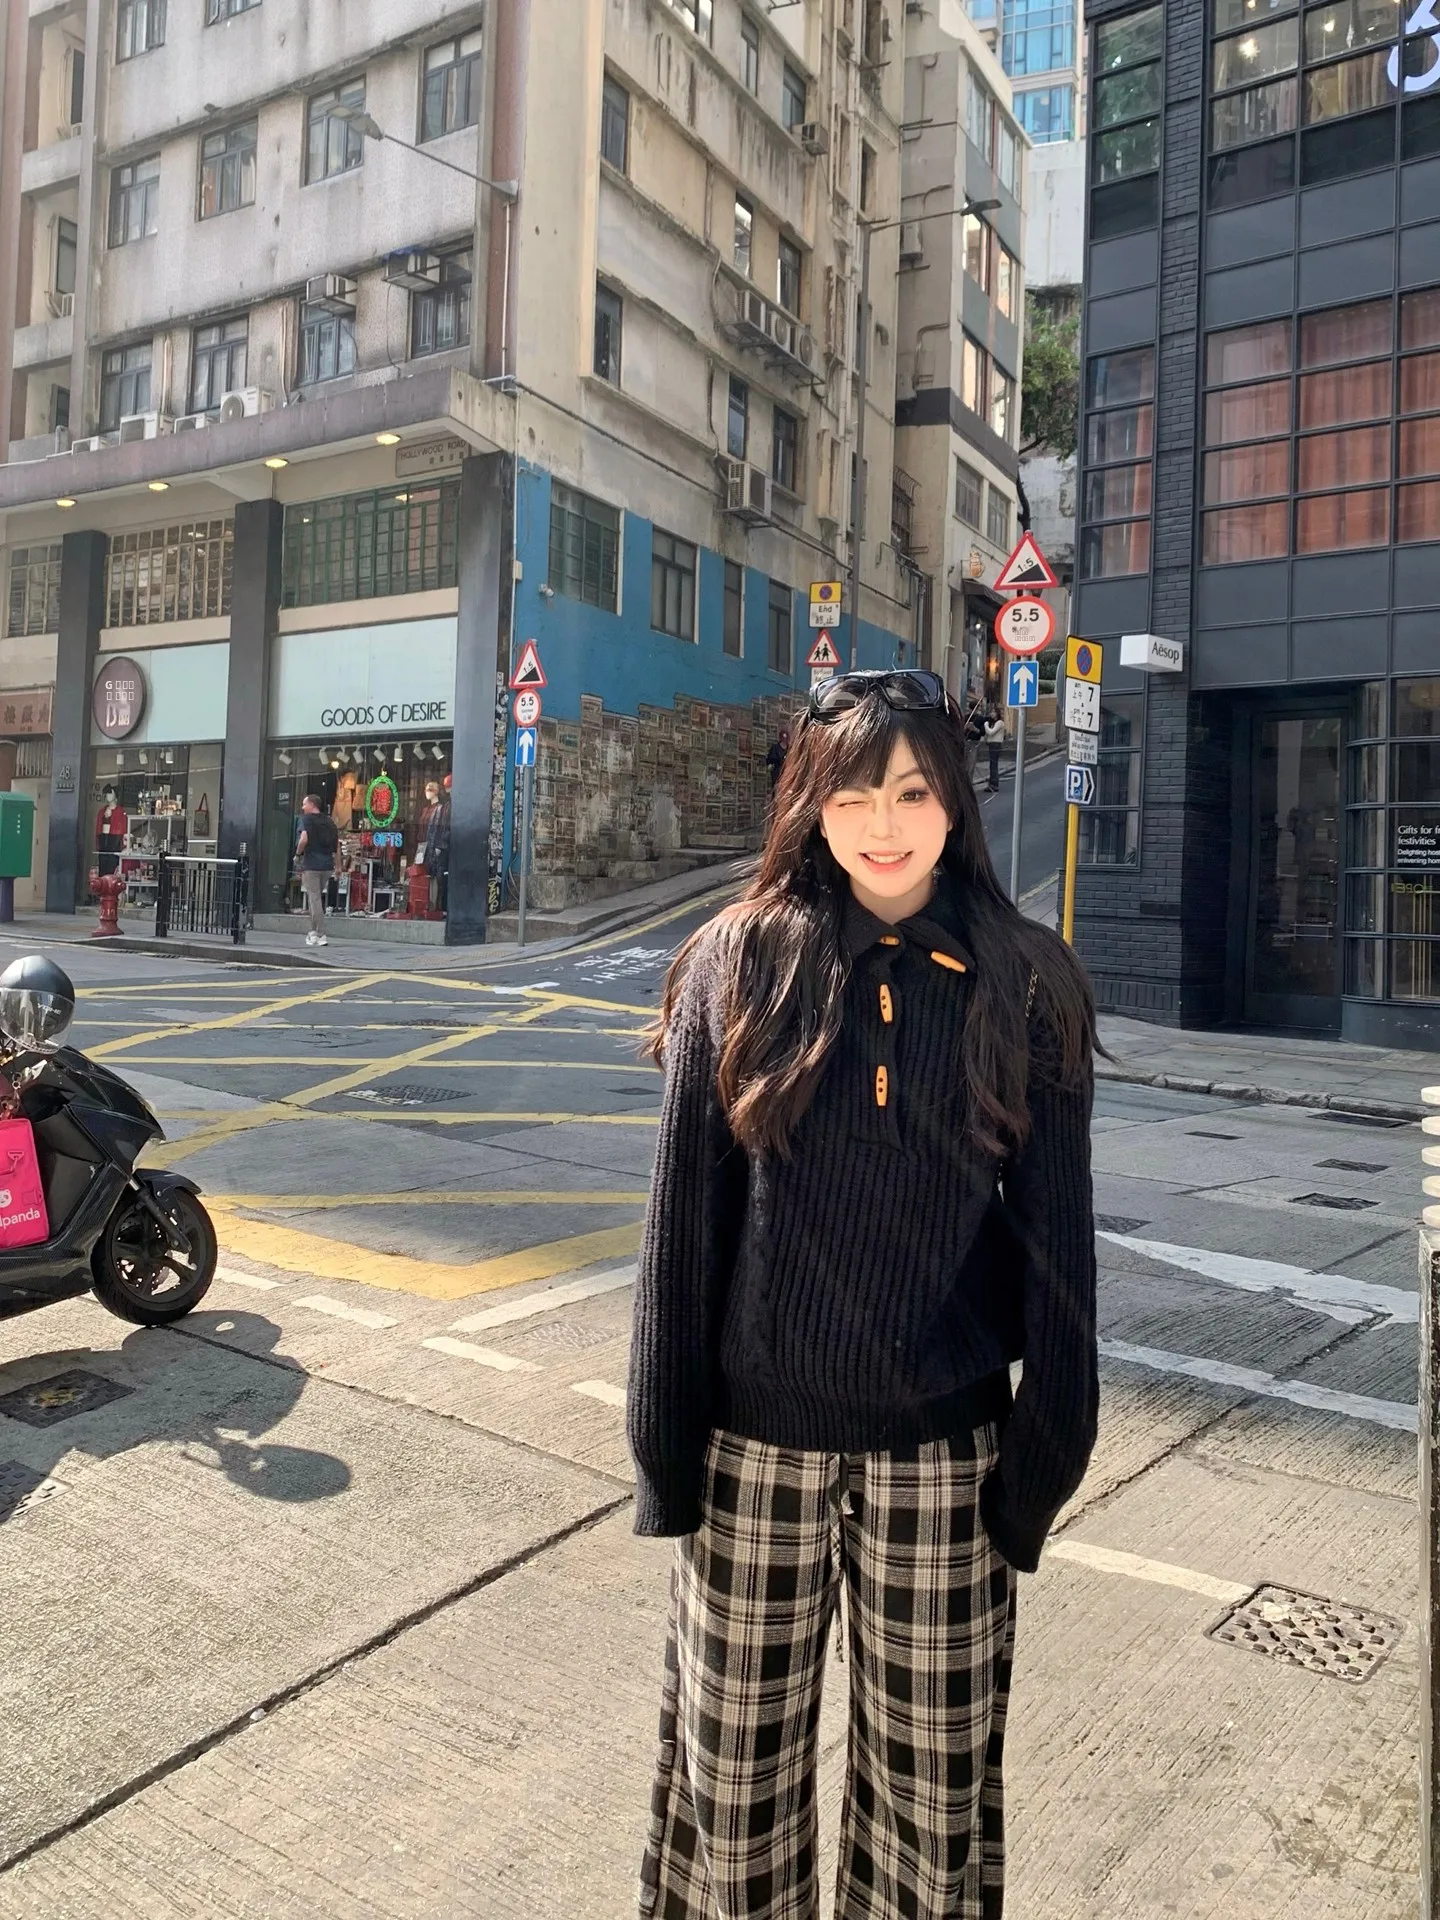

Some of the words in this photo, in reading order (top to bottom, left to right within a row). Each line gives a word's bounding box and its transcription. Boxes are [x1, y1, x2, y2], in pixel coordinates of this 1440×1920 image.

[400, 443, 443, 460] HOLLYWOOD
[447, 440, 466, 450] ROAD
[1017, 558, 1034, 573] 1:5
[818, 605, 832, 613] End
[1012, 608, 1039, 622] 5.5
[523, 661, 534, 673] 1:5
[1088, 686, 1094, 702] 7
[521, 697, 534, 706] 5.5
[321, 706, 374, 727] GOODS
[378, 704, 398, 723] OF
[401, 701, 446, 722] DESIRE
[1087, 712, 1093, 728] 7
[1398, 825, 1418, 834] Gifts
[1420, 825, 1433, 834] for
[1398, 836, 1436, 845] festivities
[1397, 849, 1427, 857] Delighting
[0, 1207, 41, 1230] panda
